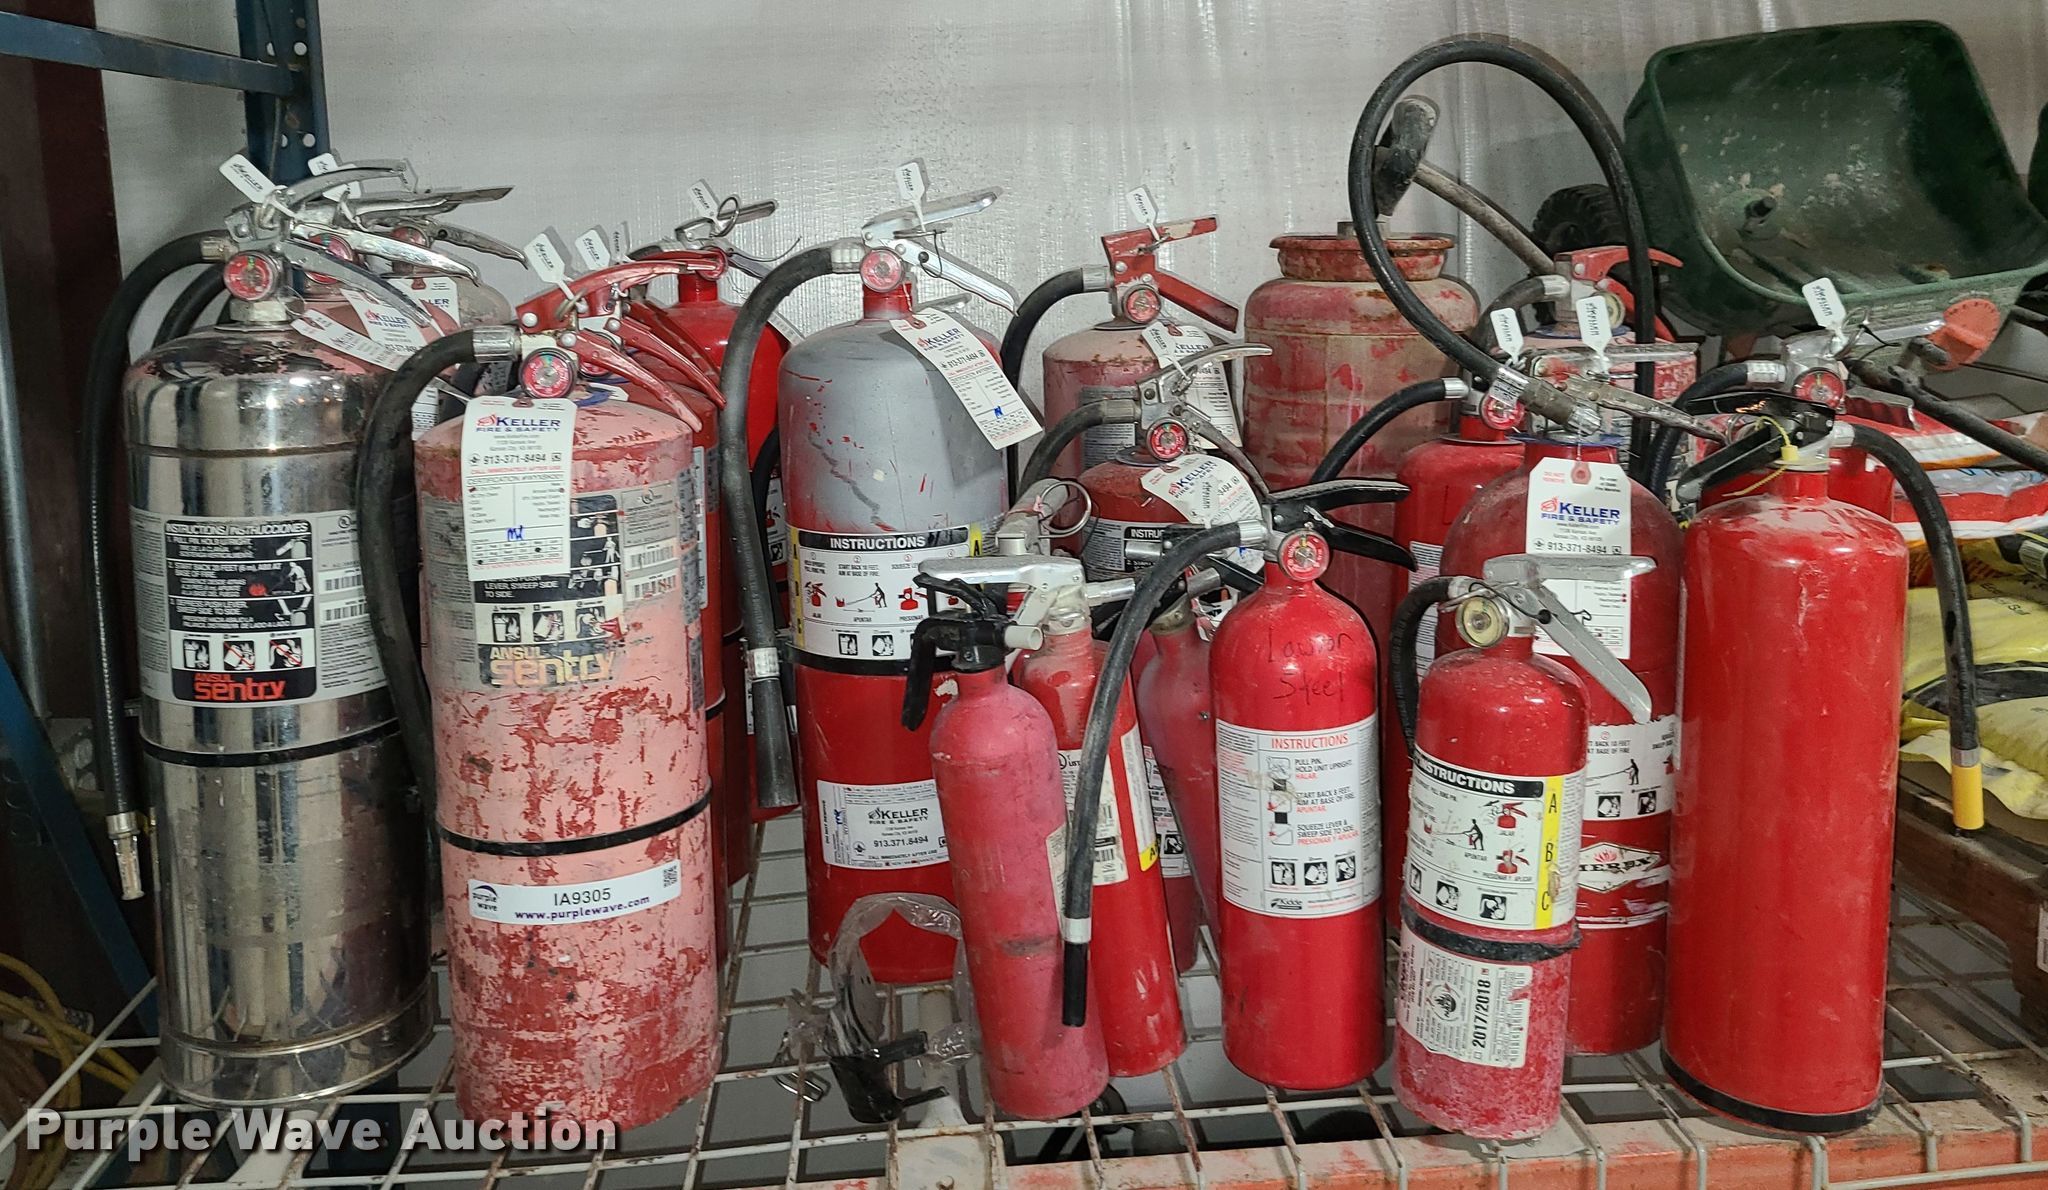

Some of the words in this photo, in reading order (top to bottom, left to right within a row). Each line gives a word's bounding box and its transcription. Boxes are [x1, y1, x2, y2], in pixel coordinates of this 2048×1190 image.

[496, 416, 561, 427] KELLER
[483, 453, 547, 465] 913-371-8494
[1176, 461, 1214, 488] KELLER
[1560, 502, 1620, 519] KELLER
[1541, 513, 1565, 521] FIRE
[1578, 516, 1620, 526] SAFETY
[830, 536, 926, 550] INSTRUCTIONS
[974, 539, 980, 557] A
[1547, 541, 1608, 554] 913-371-8494
[511, 582, 538, 590] SWEEP
[539, 580, 560, 588] SIDE
[483, 590, 494, 598] TO
[490, 646, 546, 661] ANSUL
[489, 650, 615, 687] sentry
[193, 677, 286, 701] sentry
[1273, 670, 1345, 706] Steel
[1271, 732, 1349, 750] INSTRUCTIONS
[1314, 764, 1328, 772] UNIT
[1296, 791, 1315, 799] START
[1317, 790, 1332, 798] BACK
[1320, 797, 1335, 805] BASE
[1548, 792, 1558, 814] A
[881, 807, 929, 820] KELLER
[899, 815, 929, 824] SAFETY
[1297, 822, 1324, 831] SQUEEZE
[1325, 820, 1343, 829] LEVER
[1297, 830, 1318, 838] SWEEP
[1319, 829, 1333, 837] SIDE
[873, 836, 929, 848] 913.371.8494
[1545, 842, 1554, 863] B
[472, 893, 498, 903] purple
[554, 888, 611, 906] IA9305
[1541, 890, 1550, 911] C
[477, 902, 498, 912] wave
[515, 896, 650, 920] www.purplewave.com
[1472, 979, 1492, 1049] 2017/2018
